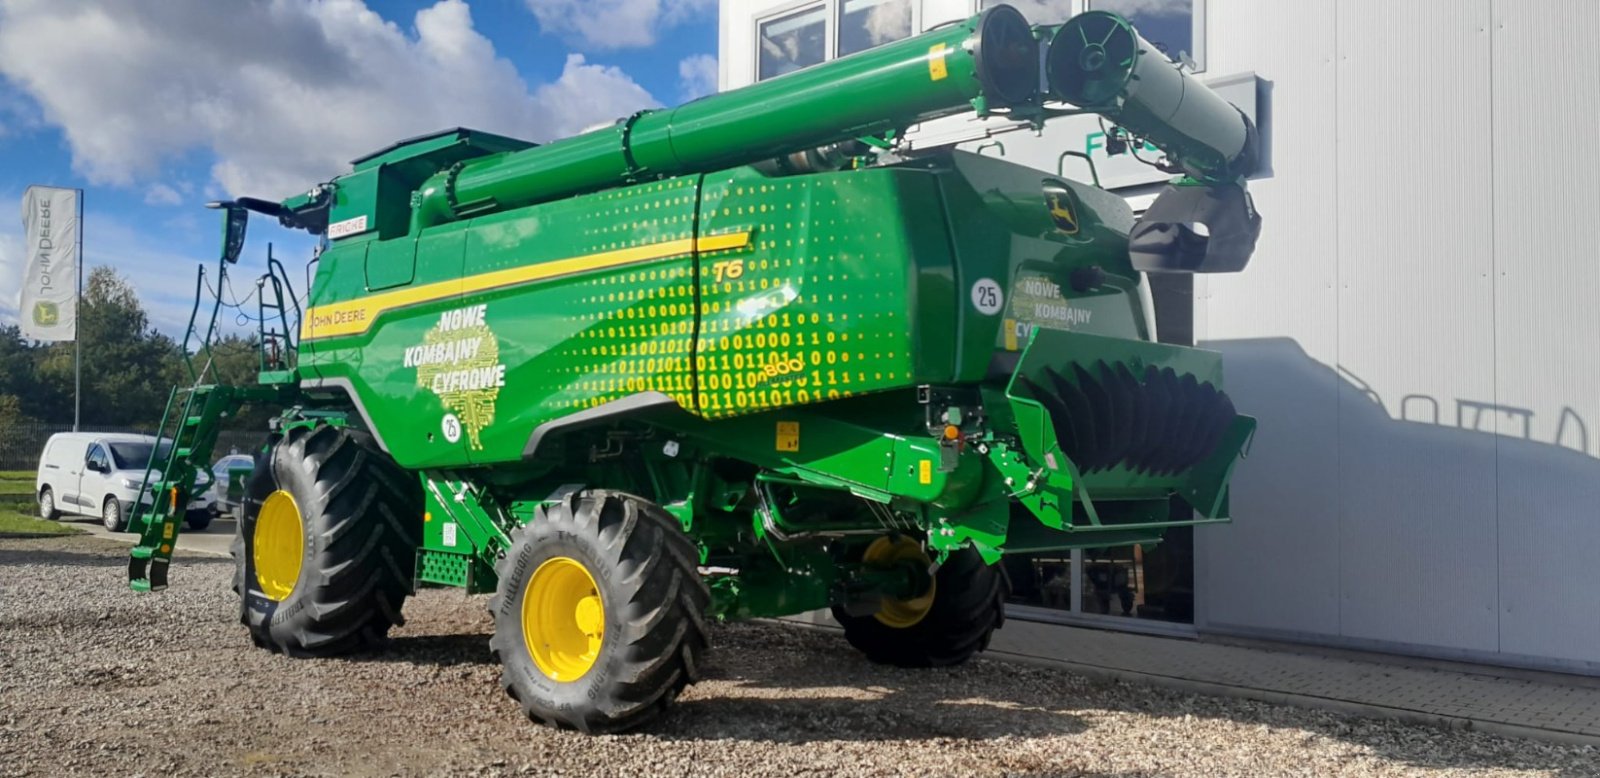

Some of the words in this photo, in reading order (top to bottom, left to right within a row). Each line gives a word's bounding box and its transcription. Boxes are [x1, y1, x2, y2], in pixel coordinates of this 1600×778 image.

[714, 259, 744, 284] T6
[978, 286, 997, 308] 25
[1025, 280, 1060, 298] NOWE
[309, 311, 332, 330] JOHN
[334, 308, 366, 325] DEERE
[440, 304, 488, 333] NOWE
[1034, 303, 1092, 325] KOMBAJNY
[404, 338, 482, 368] KOMBAJNY
[764, 358, 804, 377] 800
[432, 365, 506, 395] CYFROWE
[446, 419, 457, 437] 25
